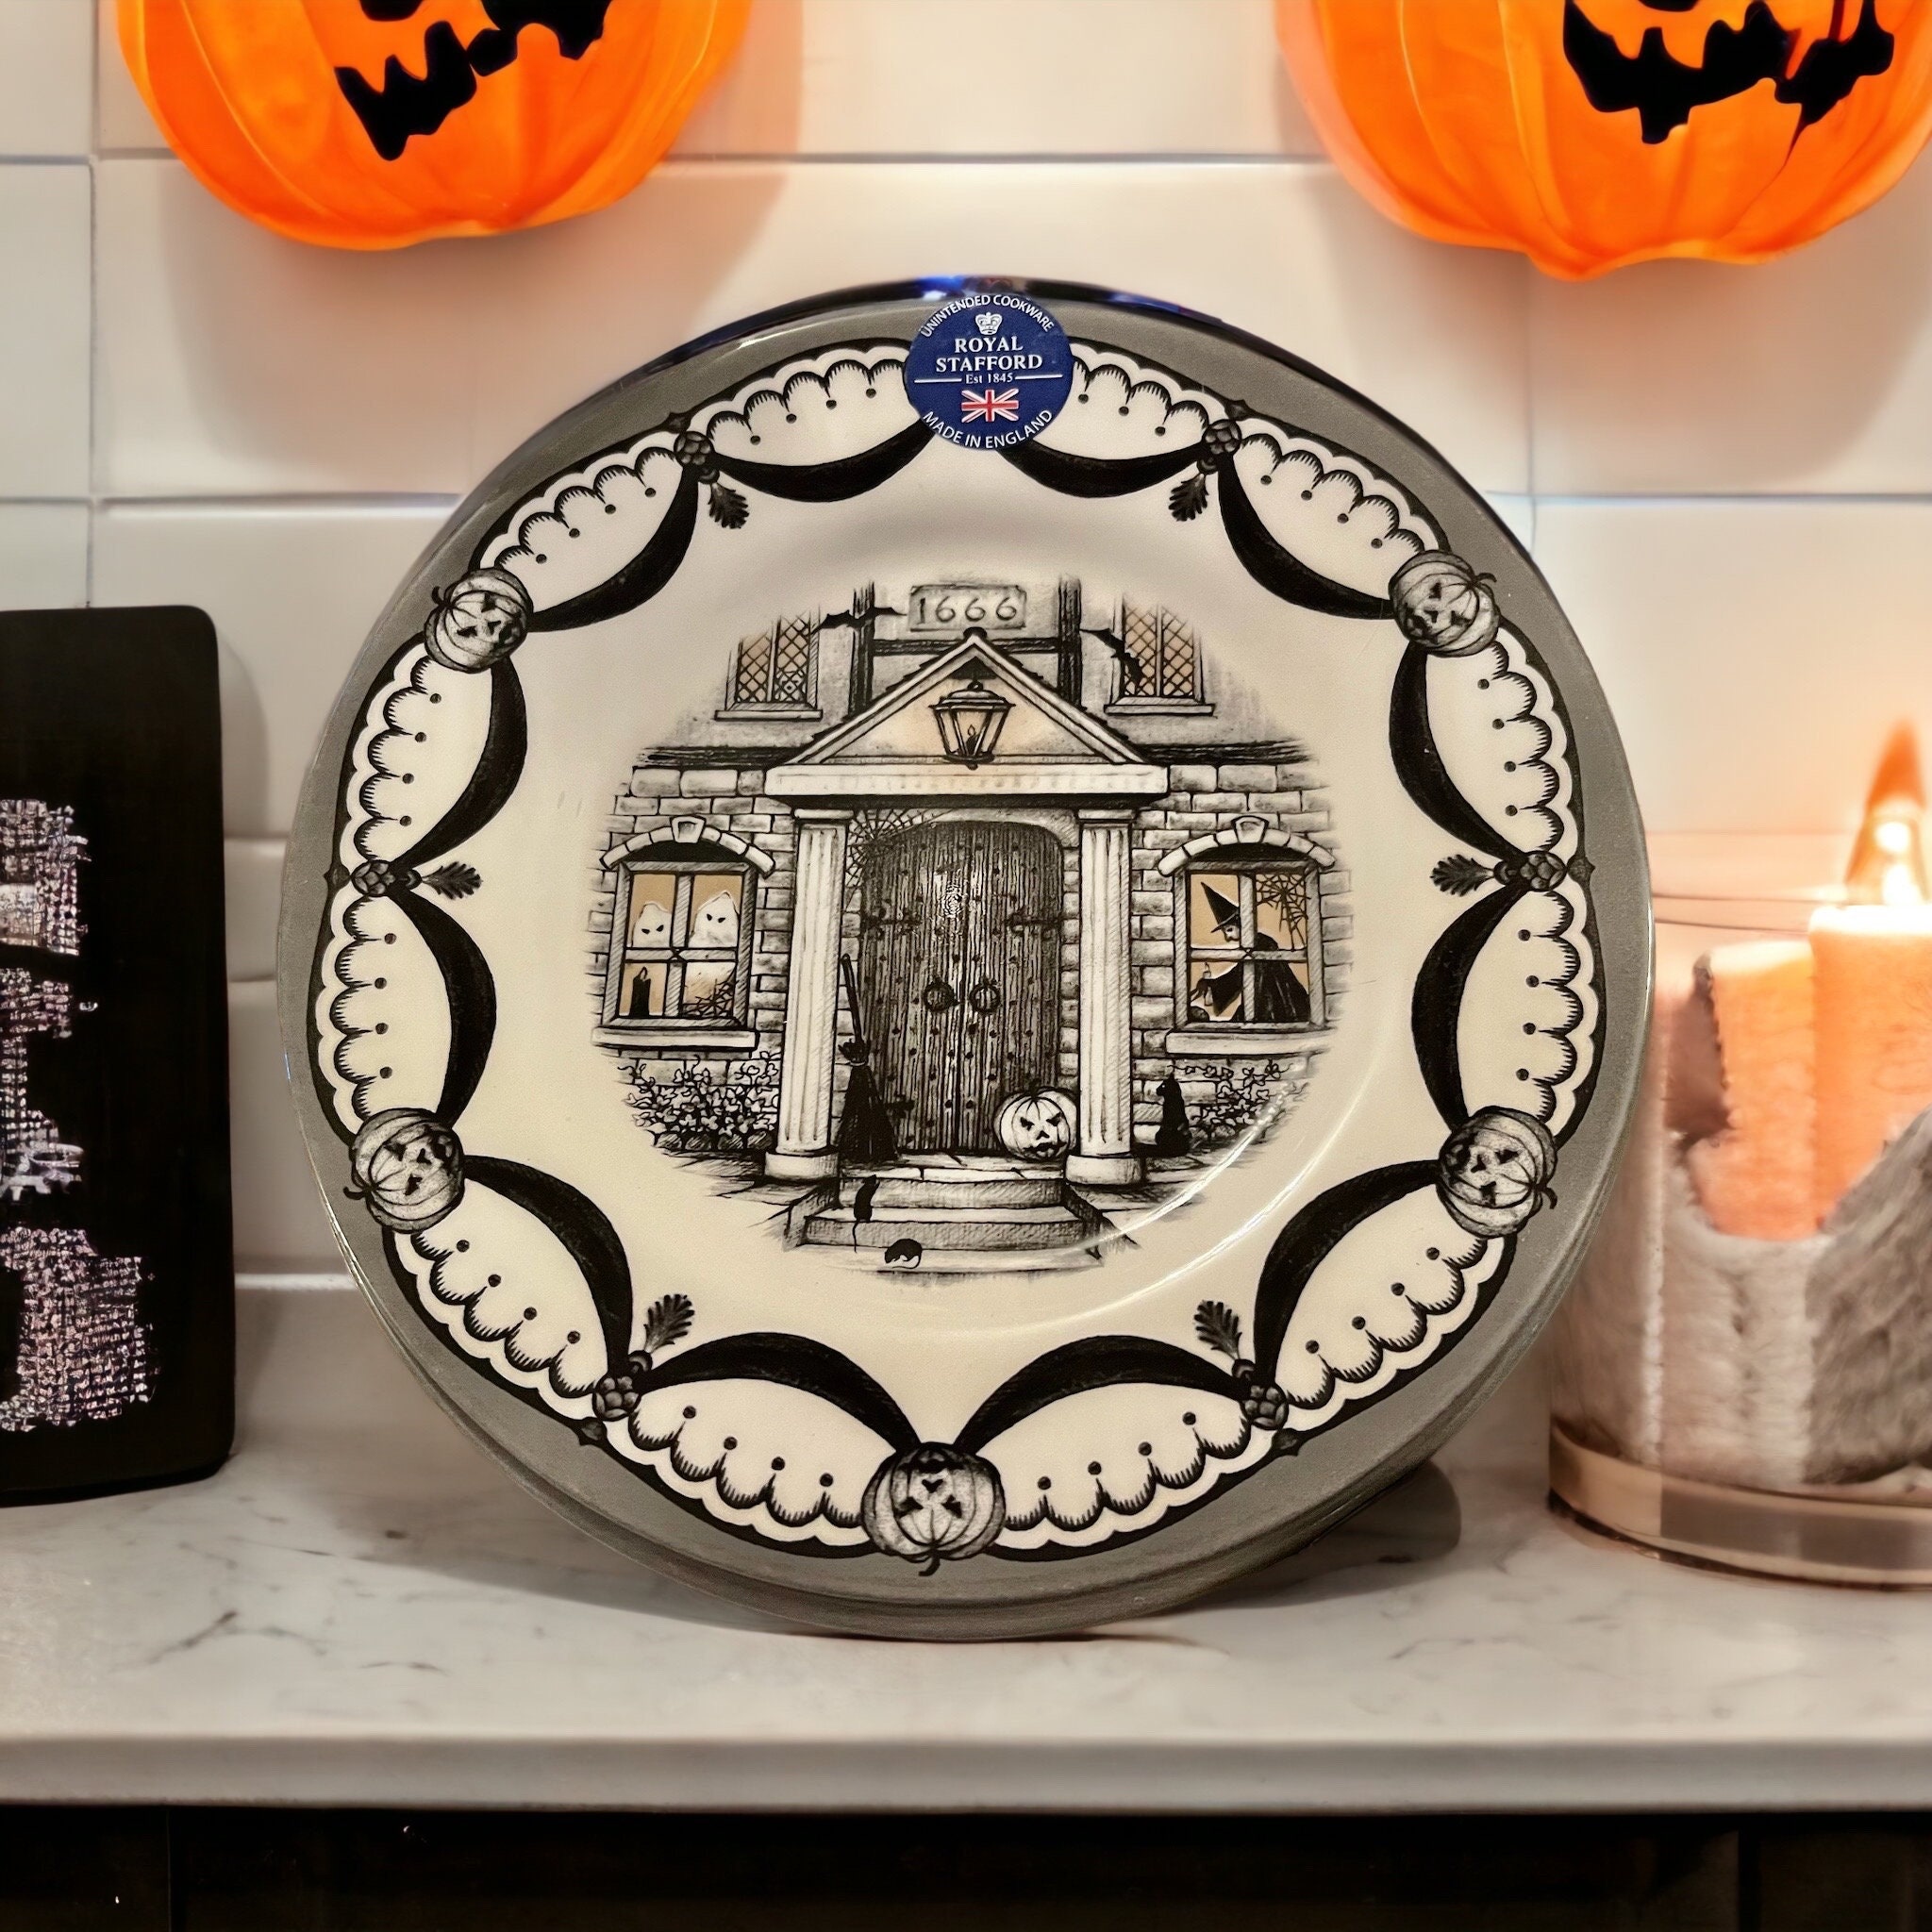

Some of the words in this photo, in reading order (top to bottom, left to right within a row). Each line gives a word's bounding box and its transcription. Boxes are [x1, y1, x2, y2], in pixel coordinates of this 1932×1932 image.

[921, 295, 991, 338] UNINTENDED
[993, 294, 1055, 332] COOKWARE
[955, 336, 1024, 354] ROYAL
[936, 354, 1043, 373] STAFFORD
[965, 374, 983, 384] Est
[987, 373, 1013, 383] 1845
[923, 411, 963, 443] MADE
[965, 434, 981, 448] IN
[986, 409, 1053, 449] ENGLAND
[917, 595, 1017, 625] 1666
